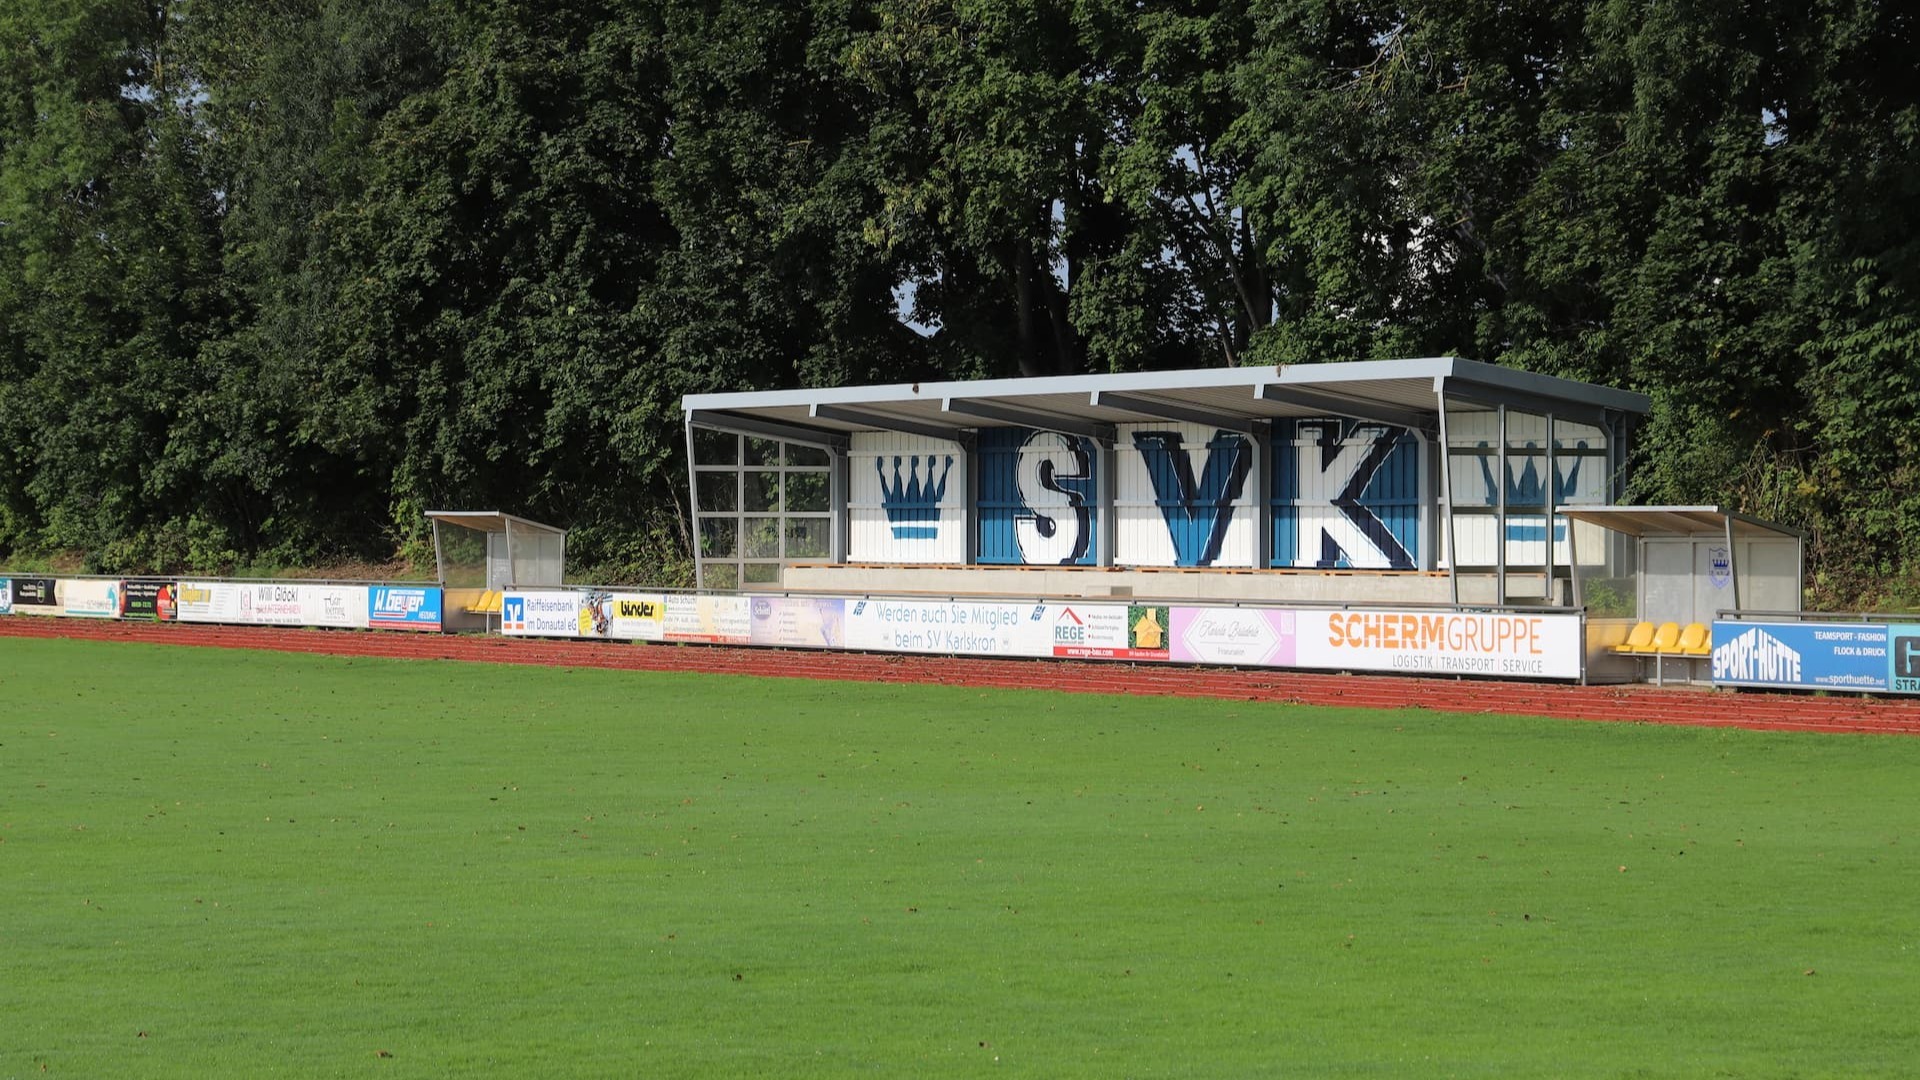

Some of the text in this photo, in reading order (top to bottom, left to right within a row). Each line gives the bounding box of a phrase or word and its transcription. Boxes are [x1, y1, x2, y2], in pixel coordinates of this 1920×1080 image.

[258, 586, 298, 602] Willi Glöckl
[527, 599, 574, 612] Raiffeisenbank
[621, 600, 654, 617] binder
[527, 618, 577, 630] im Donautal eG
[876, 603, 1018, 631] Werden auch Sie Mitglied
[1055, 626, 1084, 640] REGE
[1814, 631, 1853, 641] TEAMSPORT
[1858, 633, 1887, 642] FASHION
[895, 631, 997, 652] beim SV Karlskron
[1834, 646, 1886, 657] FLOCK & DRUCK
[1392, 655, 1543, 674] LOGISTIK TRANSPORT SERVICE
[1896, 679, 1920, 692] STR
